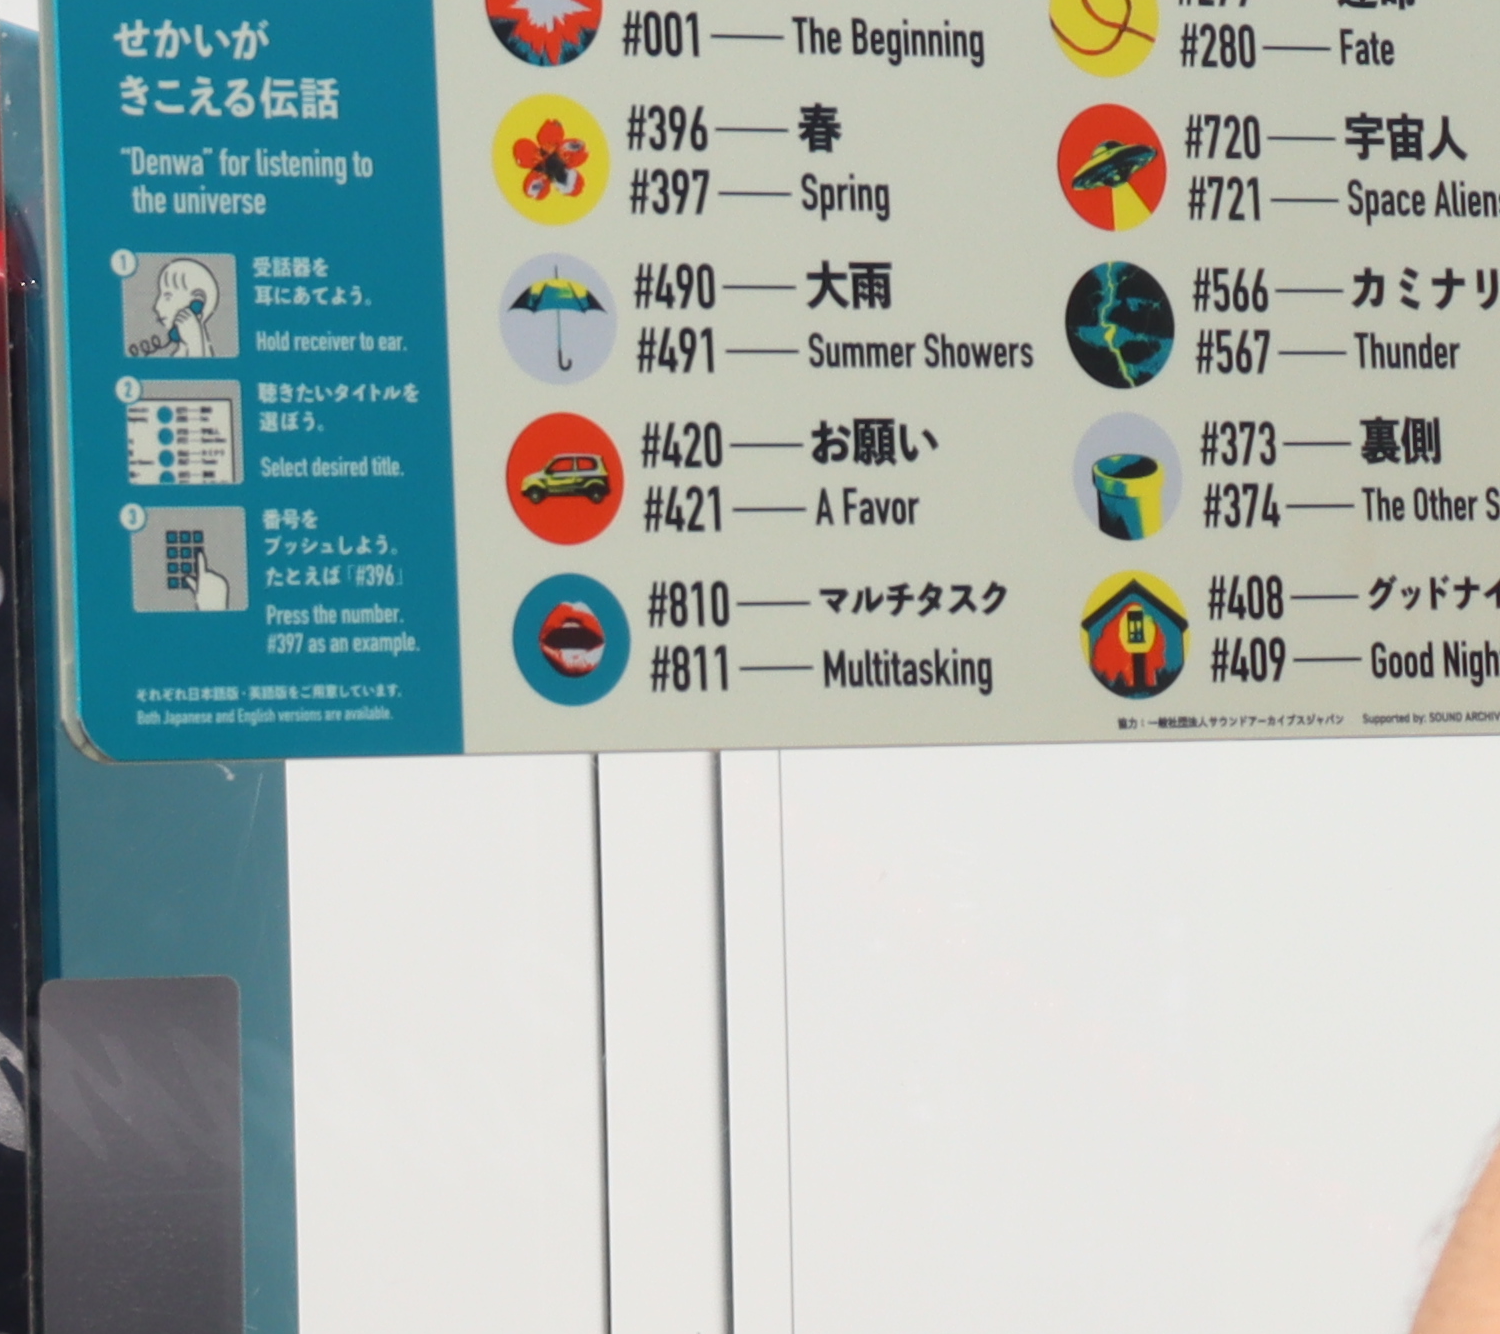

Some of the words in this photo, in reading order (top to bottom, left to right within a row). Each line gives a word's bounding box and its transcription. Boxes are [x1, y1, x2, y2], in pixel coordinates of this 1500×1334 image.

[113, 19, 269, 60] せかいが
[622, 10, 700, 57] #001
[792, 15, 841, 56] The
[851, 19, 985, 67] Beginning
[1180, 23, 1256, 68] #280
[1340, 28, 1395, 66] Fate
[119, 76, 339, 119] きこえる伝話
[626, 104, 709, 151] #396
[798, 103, 841, 153] 春
[1185, 113, 1261, 159] #720
[1344, 112, 1468, 161] 宇宙人
[219, 149, 248, 177] for
[255, 149, 347, 184] listening
[353, 151, 373, 178] to
[133, 185, 166, 214] the
[174, 186, 266, 214] universe
[629, 168, 710, 214] #397
[801, 173, 891, 221] Spring
[1188, 176, 1260, 221] #721
[1347, 179, 1425, 226] Space
[1434, 180, 1500, 217] Alien
[253, 256, 329, 278] 受話器を
[633, 262, 716, 309] #490
[806, 261, 893, 309] 大雨
[1192, 267, 1269, 312] #566
[1351, 267, 1500, 310] カミナリ
[254, 285, 372, 307] 耳にあてよう。
[256, 331, 290, 351] Hold
[294, 331, 356, 351] receiver
[359, 332, 374, 351] to
[378, 335, 407, 352] ear.
[636, 327, 716, 373] #491
[808, 334, 915, 369] Summer
[923, 333, 1033, 369] Showers
[1196, 329, 1270, 374] #567
[1354, 332, 1460, 370] Thunder
[257, 382, 419, 403] 聴きたいタイトルを
[259, 411, 325, 432] 選ぼう。
[641, 421, 723, 468] #420
[810, 418, 939, 465] お願い
[1200, 421, 1277, 466] #373
[1359, 416, 1441, 465] 裏側
[260, 456, 308, 477] Select
[312, 456, 368, 477] desired
[372, 456, 404, 477] title.
[263, 509, 318, 530] 番号を
[643, 486, 722, 532] #421
[816, 487, 833, 526] A
[843, 487, 920, 525] Favor
[1203, 483, 1280, 528] #374
[1361, 486, 1405, 521] The
[1413, 486, 1478, 521] Other
[266, 604, 309, 625] Press
[313, 604, 337, 624] the
[341, 603, 404, 624] number.
[647, 580, 730, 628] #810
[819, 581, 1008, 617] マルチタスク
[1208, 575, 1284, 620] #408
[267, 633, 304, 653] #397
[308, 637, 326, 653] as
[330, 637, 348, 653] an
[352, 632, 420, 657] example.
[1212, 637, 1286, 683] #409
[1371, 641, 1434, 679] Good
[1443, 640, 1500, 688] Nigh
[650, 645, 729, 692] #811
[822, 650, 993, 695] Multitasking
[137, 710, 161, 725] Both
[163, 710, 212, 727] Japanese
[215, 709, 235, 724] and
[237, 708, 276, 726] English
[278, 708, 322, 723] versions
[325, 709, 342, 722] are
[1363, 713, 1410, 725] Supported
[1429, 712, 1463, 724] SOUND
